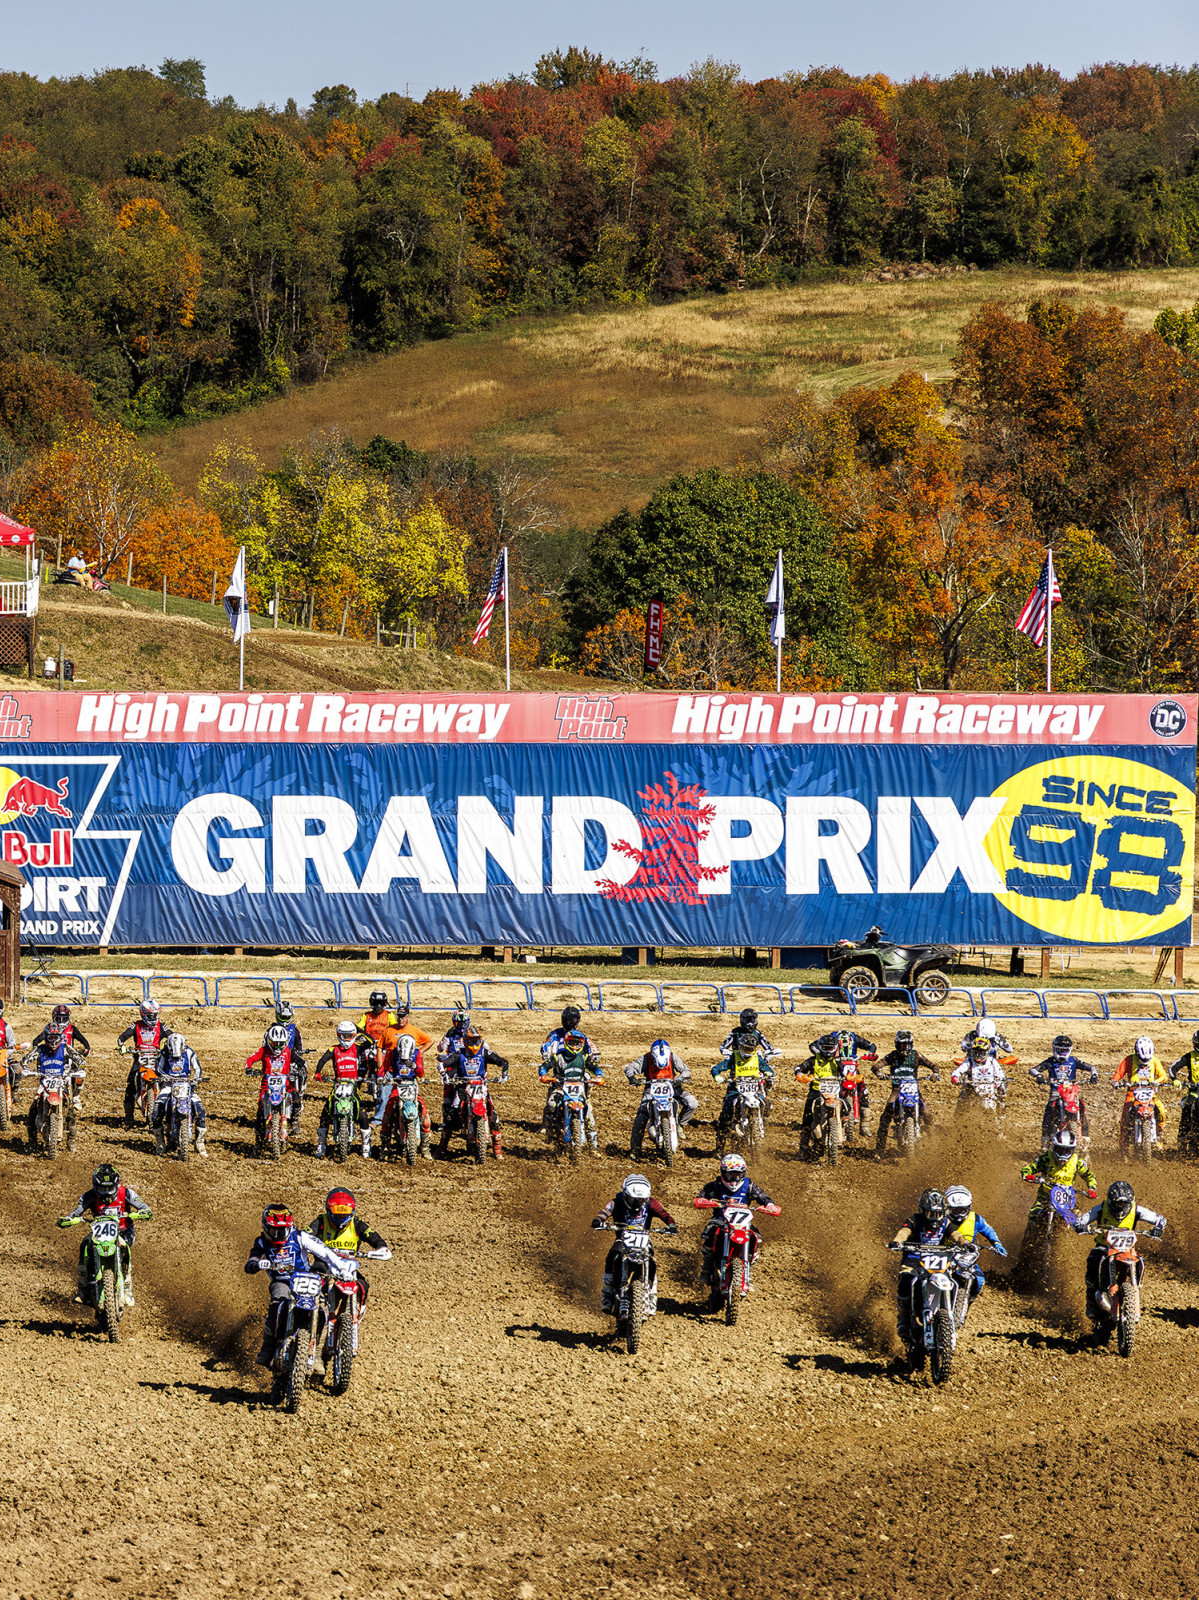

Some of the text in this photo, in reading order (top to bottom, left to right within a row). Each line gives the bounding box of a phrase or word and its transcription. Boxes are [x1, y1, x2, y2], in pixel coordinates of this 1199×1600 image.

[77, 693, 510, 743] High Point Raceway
[555, 696, 614, 720] High
[559, 716, 627, 740] Point
[672, 695, 1104, 745] High Point Raceway
[1155, 709, 1181, 730] DC
[1042, 775, 1178, 817] SINCE
[2, 829, 74, 868] Bull
[171, 792, 1008, 896] GRAND PRIX
[1006, 804, 1186, 916] 98
[19, 920, 59, 935] AND
[62, 920, 100, 935] PRIX
[269, 1077, 284, 1086] 59
[566, 1085, 580, 1094] 14
[728, 1211, 750, 1224] 17
[93, 1223, 117, 1238] 246
[343, 1241, 356, 1249] CITY
[921, 1256, 948, 1270] 121
[293, 1277, 320, 1296] 126
